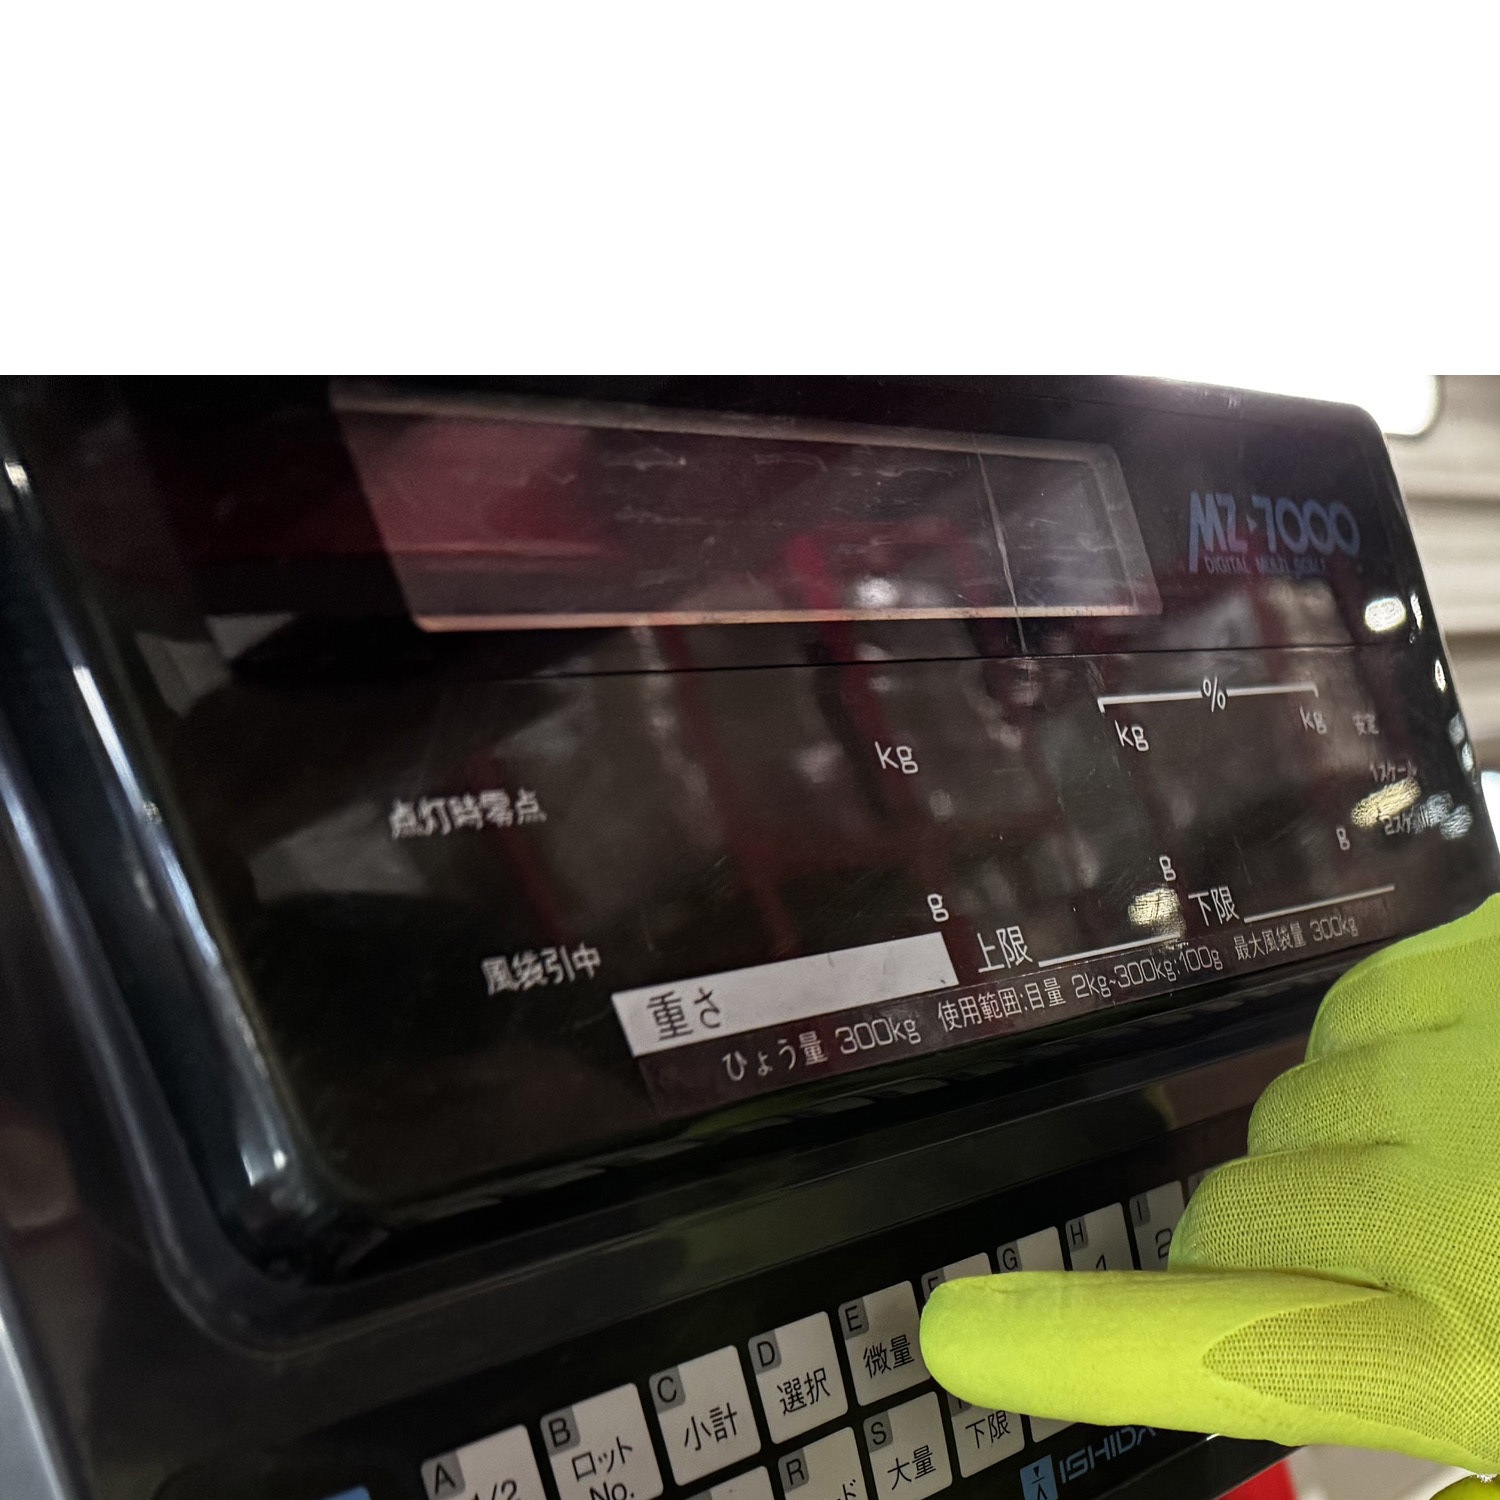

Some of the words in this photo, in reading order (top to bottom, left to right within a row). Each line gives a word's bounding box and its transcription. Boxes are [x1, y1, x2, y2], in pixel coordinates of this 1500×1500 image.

[1205, 556, 1249, 574] DIGITAL
[1202, 677, 1226, 711] %
[1115, 719, 1150, 752] kg
[1300, 706, 1327, 735] kg
[874, 741, 919, 775] kg
[1336, 825, 1350, 851] g
[1158, 855, 1177, 881] g
[926, 893, 950, 922] g
[1188, 886, 1239, 927] 下限
[977, 925, 1033, 973] 上限
[722, 1030, 828, 1082] ひょう量
[834, 1018, 921, 1055] 300kg
[1309, 915, 1359, 942] 300kg
[645, 988, 723, 1043] 重さ
[1069, 1224, 1085, 1246] H
[1002, 1248, 1018, 1271] G
[844, 1305, 863, 1332] E
[757, 1340, 776, 1367] D
[862, 1335, 915, 1379] 微量
[656, 1376, 678, 1403] C
[776, 1367, 831, 1416] 選択
[549, 1418, 572, 1448] B
[682, 1402, 739, 1452] 小計
[870, 1422, 888, 1446] S
[965, 1410, 1011, 1449] 下限
[571, 1436, 634, 1482] ロット
[784, 1457, 804, 1487] R
[887, 1444, 935, 1491] 大量
[433, 1461, 457, 1495] A
